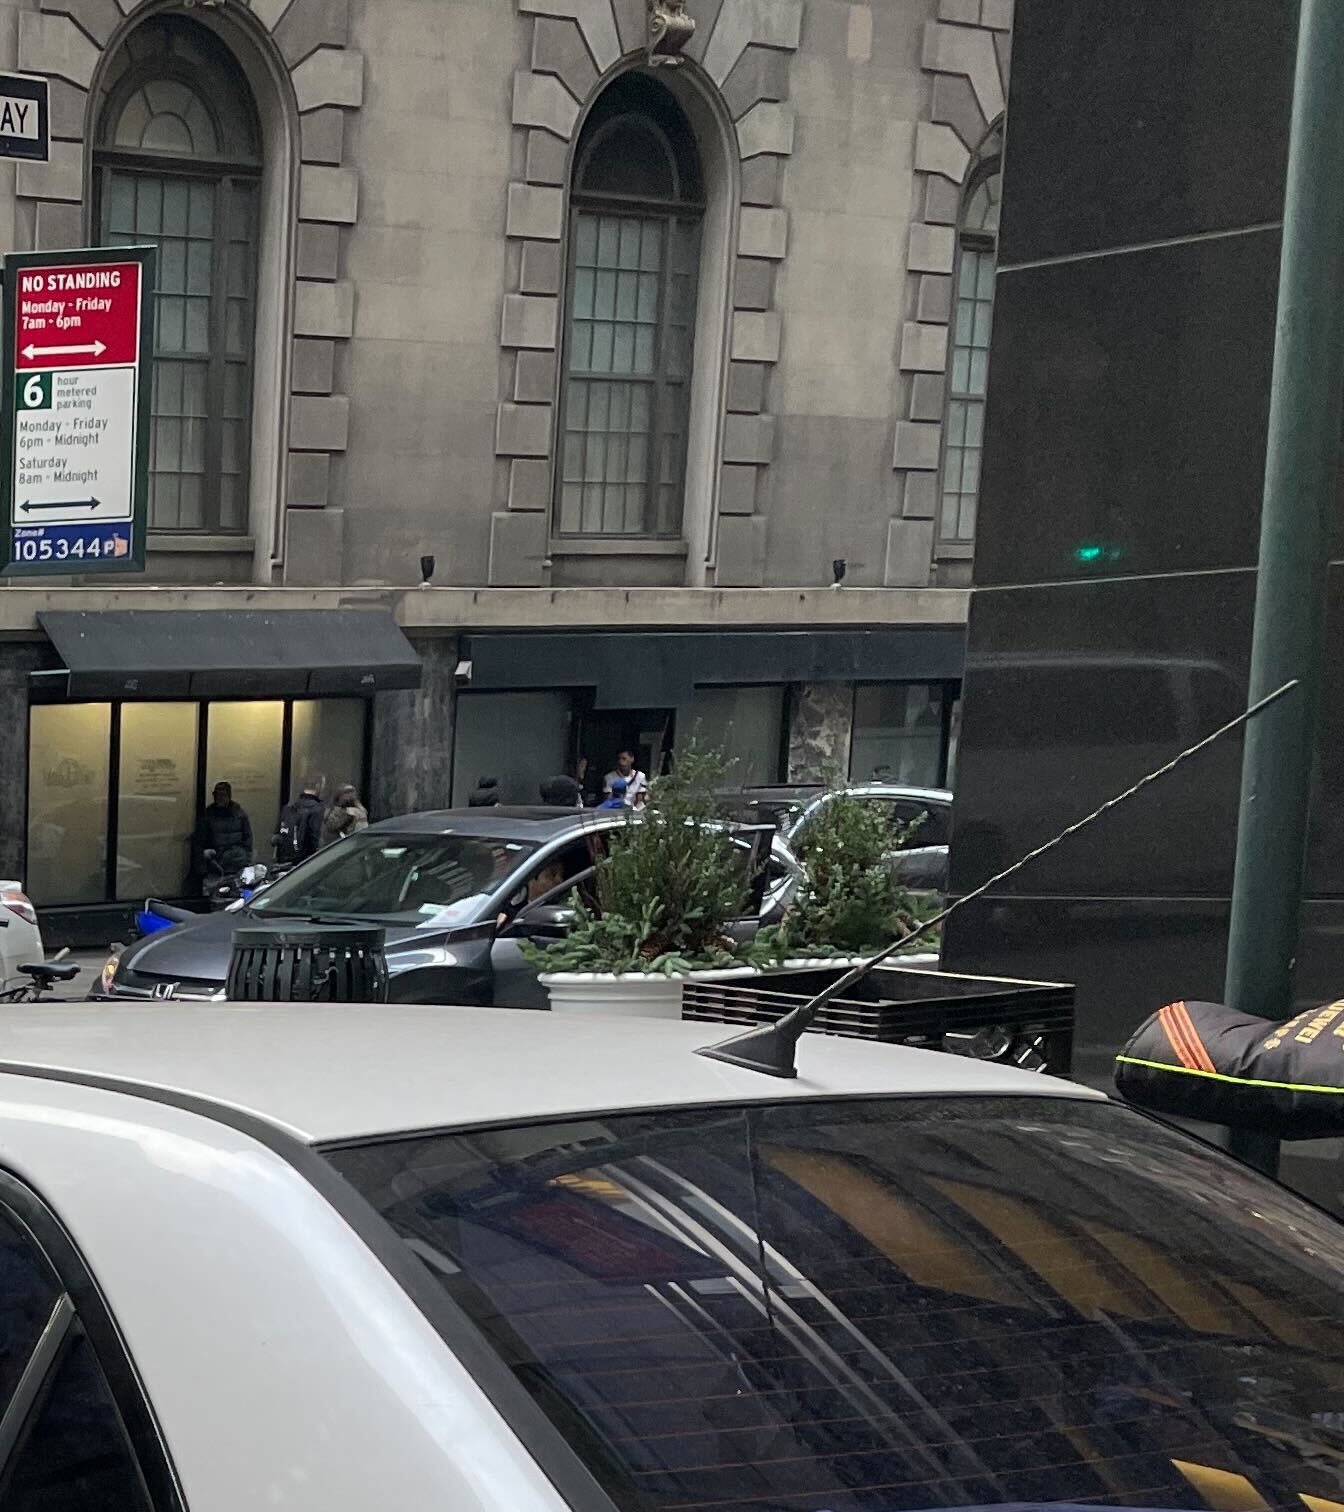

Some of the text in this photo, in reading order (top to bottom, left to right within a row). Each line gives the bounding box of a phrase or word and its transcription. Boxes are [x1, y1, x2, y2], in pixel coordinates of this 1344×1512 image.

[22, 271, 121, 293] NO STANDING
[21, 299, 66, 316] Monday
[75, 297, 113, 312] Friday
[21, 316, 46, 330] 7am
[56, 315, 81, 330] 6pm
[57, 376, 79, 386] hour
[23, 374, 44, 408] 6
[56, 386, 97, 398] metered
[56, 398, 92, 411] parking
[19, 420, 62, 434] Monday
[73, 417, 109, 431] Friday
[19, 436, 44, 450] 6pm
[55, 432, 99, 447] Midnight
[19, 457, 68, 470] Saturday
[18, 473, 43, 485] 8am
[53, 469, 99, 484] Midnight
[14, 528, 45, 538] Zone#
[14, 538, 101, 561] 105344
